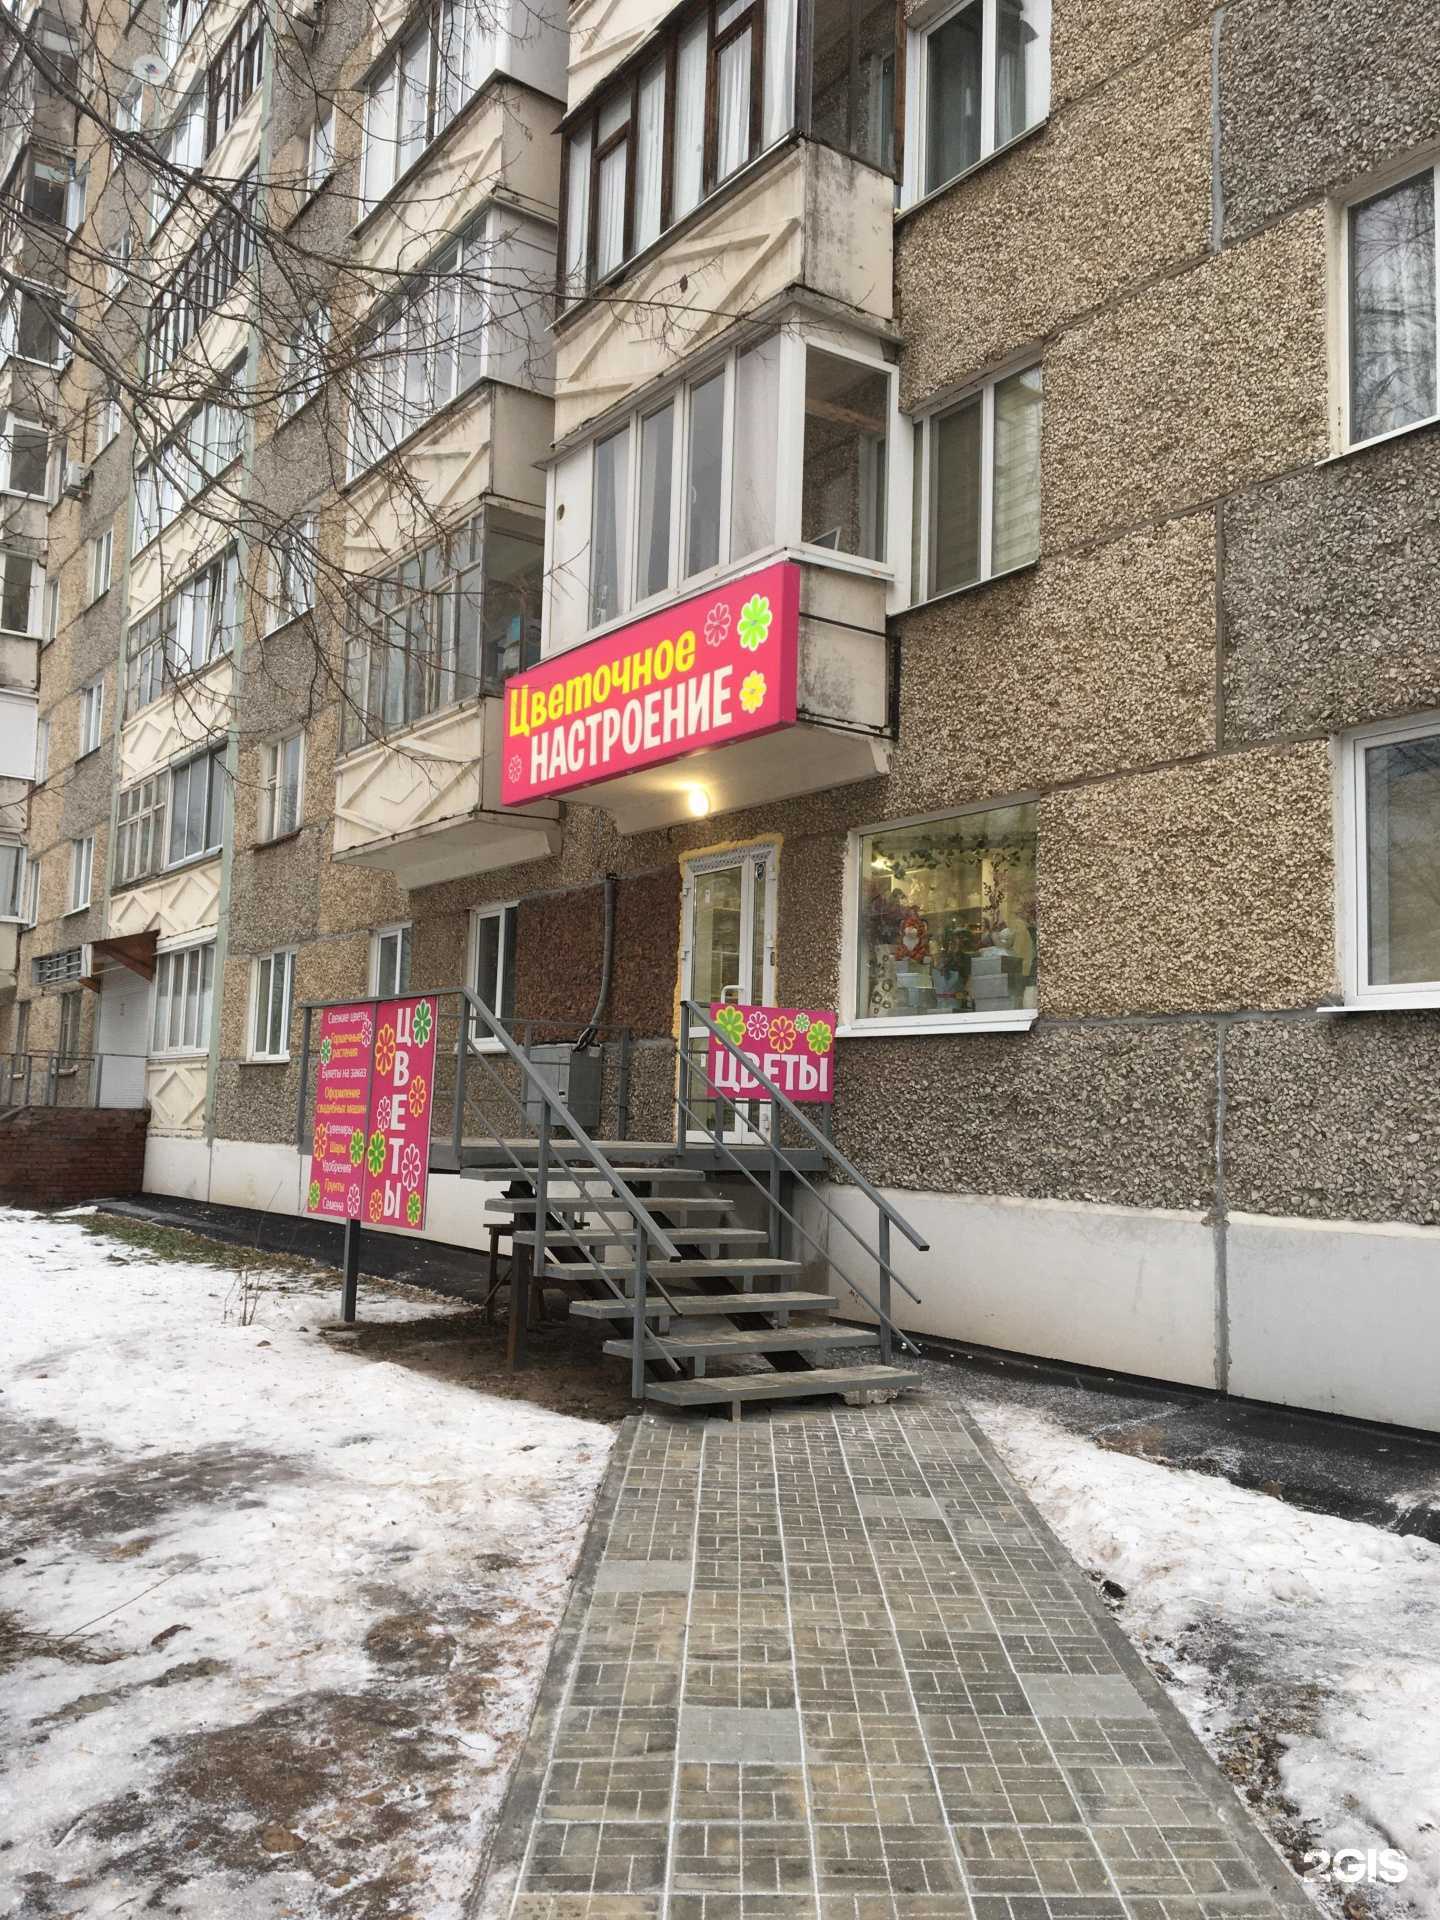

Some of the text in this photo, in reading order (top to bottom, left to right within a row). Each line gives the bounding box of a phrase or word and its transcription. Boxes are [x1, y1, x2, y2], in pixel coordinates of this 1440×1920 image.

[509, 630, 696, 737] Цветочное
[530, 664, 733, 784] НАСТРОЕНИЕ
[328, 1011, 369, 1024] Свежие цветы
[331, 1032, 361, 1044] Горшечные
[332, 1048, 358, 1059] растения
[322, 1067, 367, 1080] Букеты на заказ
[714, 1051, 828, 1092] ЦВЕТЫ
[324, 1087, 361, 1100] Оформление
[317, 1102, 367, 1114] свадебных машин
[383, 1007, 412, 1219] ЦВЕТЫ
[326, 1122, 354, 1136] Сувениры
[329, 1142, 346, 1155] Шары
[322, 1160, 352, 1174] Удобрения
[324, 1178, 346, 1192] Грунты
[322, 1197, 344, 1212] Семена
